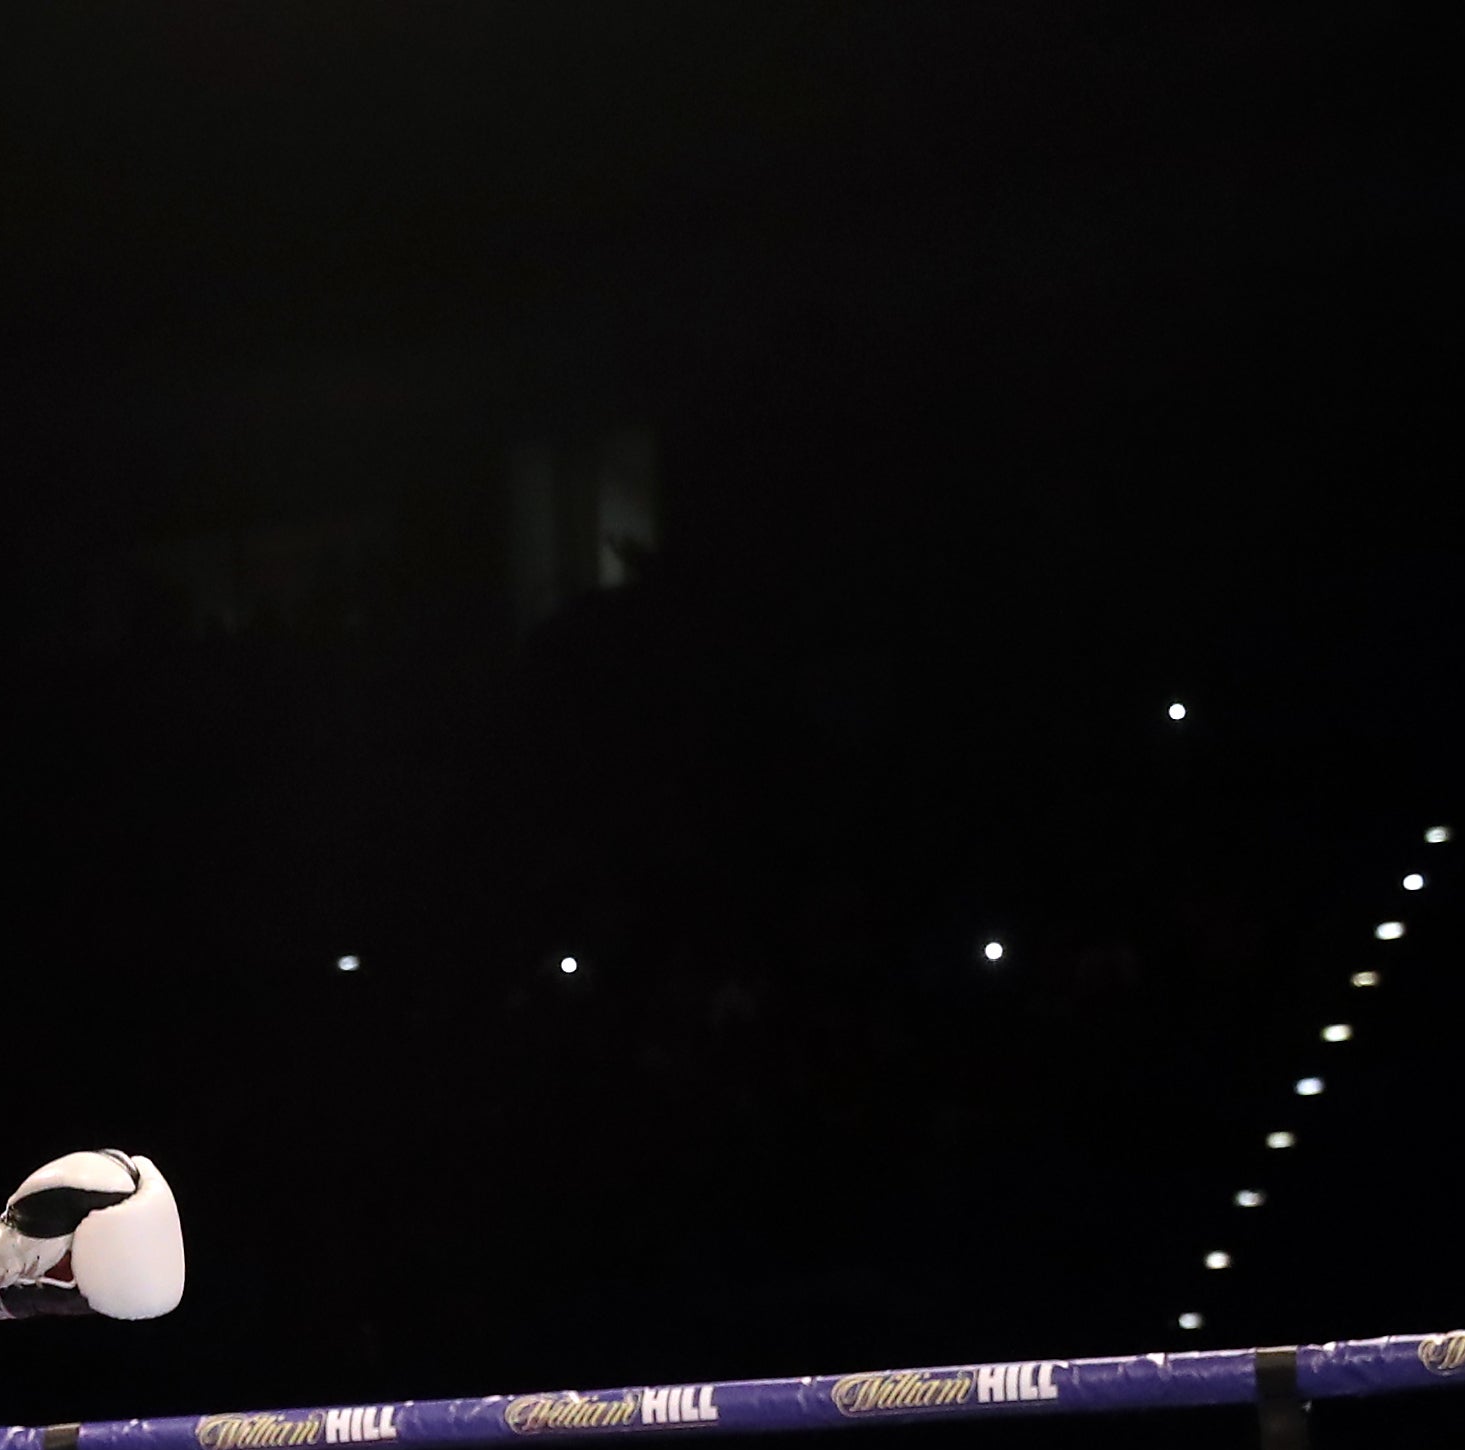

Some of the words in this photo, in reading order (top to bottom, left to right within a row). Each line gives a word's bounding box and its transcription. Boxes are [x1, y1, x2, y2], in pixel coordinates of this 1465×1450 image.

[505, 1388, 640, 1436] William
[641, 1385, 719, 1424] HILL
[833, 1370, 975, 1415] William
[977, 1362, 1059, 1403] HILL
[325, 1405, 397, 1444] HILL
